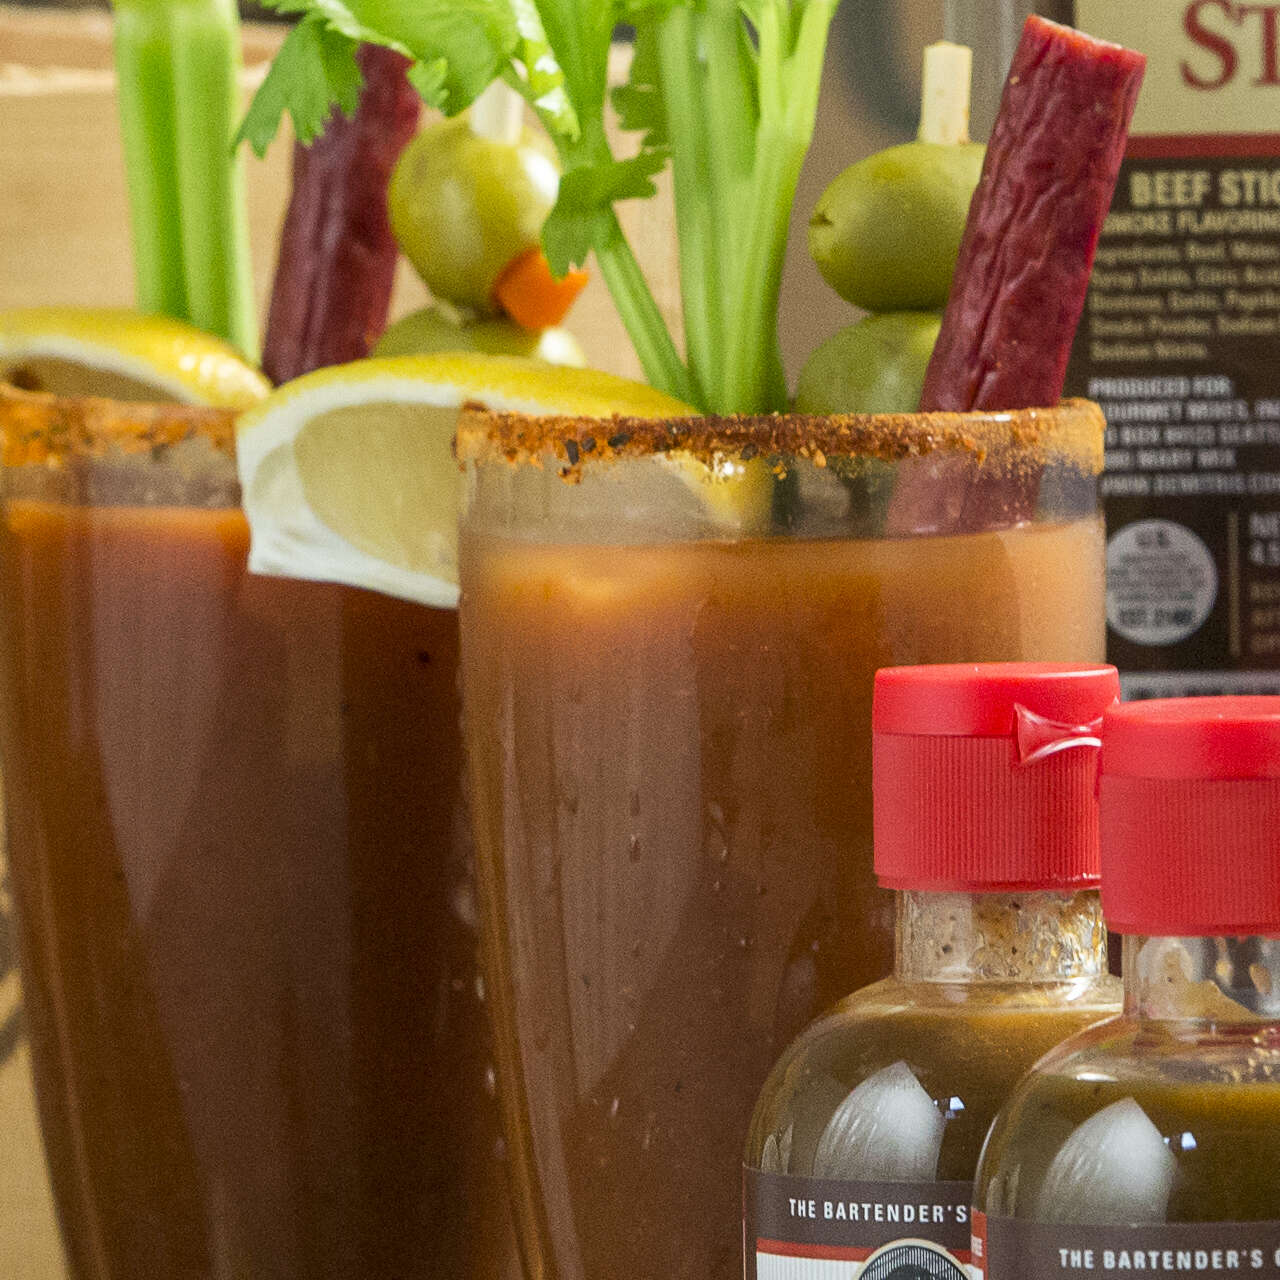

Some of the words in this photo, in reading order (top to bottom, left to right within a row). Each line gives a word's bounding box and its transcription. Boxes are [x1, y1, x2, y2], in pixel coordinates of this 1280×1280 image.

[1129, 170, 1211, 207] BEEF
[789, 1198, 816, 1220] THE
[824, 1199, 968, 1224] BARTENDER'S
[1059, 1247, 1094, 1270] THE
[1104, 1249, 1263, 1271] BARTENDER'S
